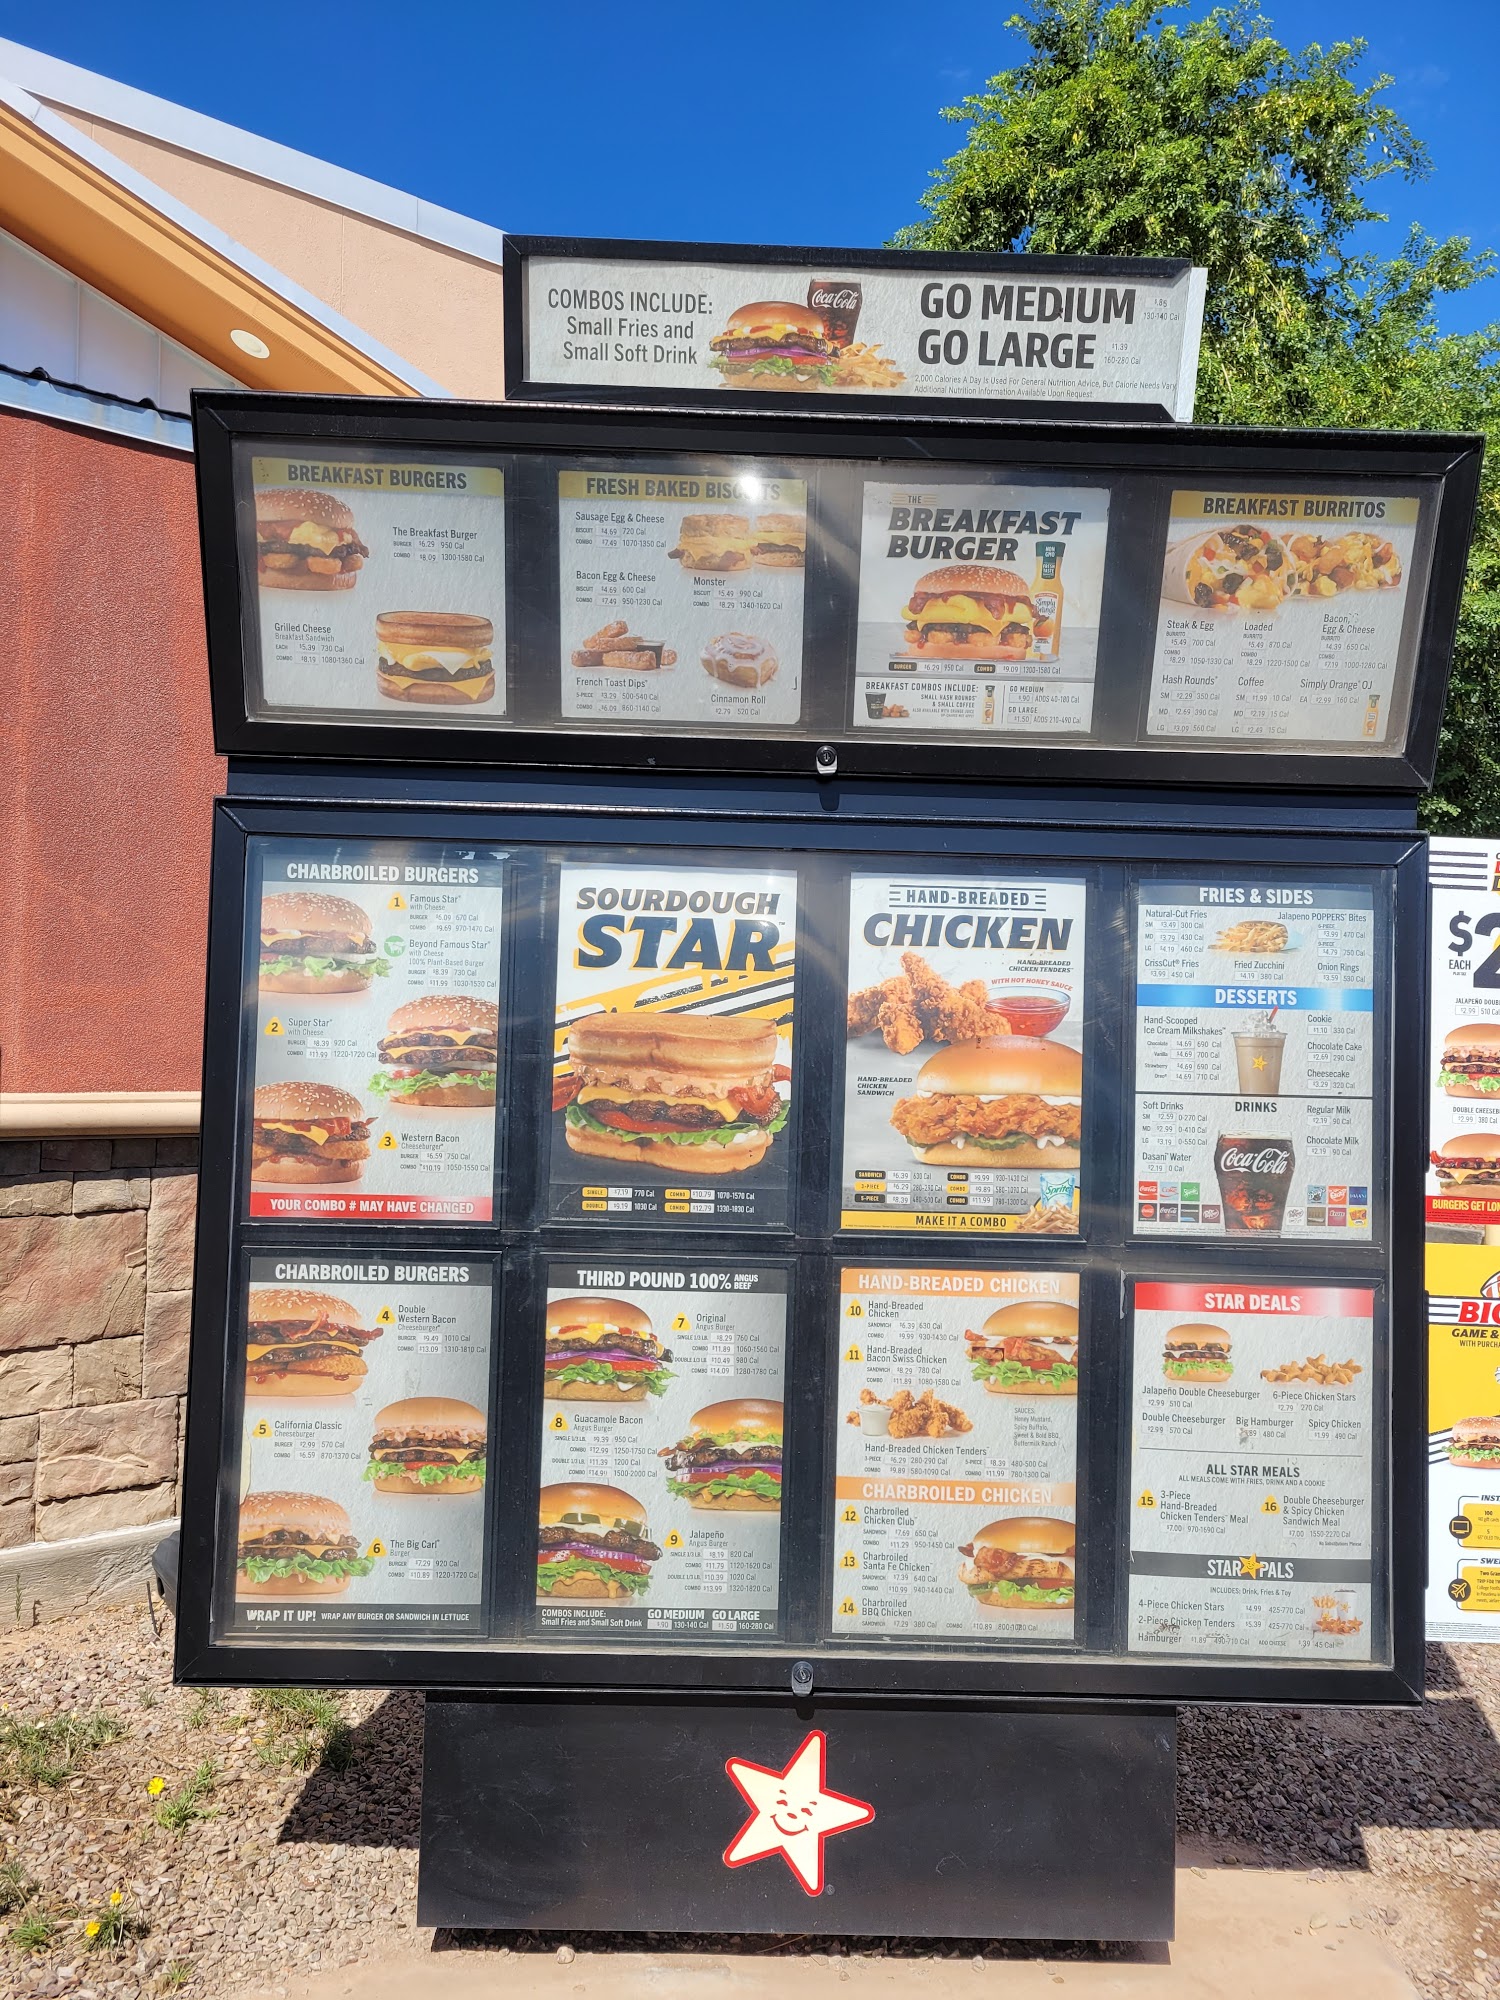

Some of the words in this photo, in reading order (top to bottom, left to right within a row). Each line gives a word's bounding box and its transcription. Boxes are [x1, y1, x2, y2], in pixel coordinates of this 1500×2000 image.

[548, 288, 625, 310] COMBOS
[629, 291, 713, 315] INCLUDE:
[920, 283, 972, 319] GO
[981, 285, 1136, 324] MEDIUM
[567, 316, 613, 336] Small
[618, 318, 658, 337] Fries
[664, 320, 694, 339] and
[563, 341, 609, 361] Small
[614, 343, 649, 363] Soft
[653, 344, 698, 365] Drink
[918, 329, 969, 365] GO
[978, 331, 1096, 369] LARGE
[288, 464, 384, 486] BREAKFAST
[390, 470, 467, 489] BURGERS
[586, 478, 639, 495] FRESH
[645, 480, 700, 497] BAKED
[706, 481, 781, 500] BISCTS
[908, 496, 922, 504] THE
[1203, 498, 1299, 516] BREAKFAST
[1303, 500, 1385, 518] BURRITOS
[575, 512, 608, 523] Sausage
[611, 513, 625, 524] Egg
[627, 514, 633, 522] &
[635, 514, 665, 524] Cheese
[888, 507, 1082, 535] BREAKFAST
[393, 527, 407, 537] The
[409, 528, 448, 538] Breakfast
[450, 530, 477, 540] Burger
[887, 535, 1019, 561] BURGER
[694, 577, 726, 586] Monster
[274, 623, 300, 633] Grilled
[302, 624, 331, 634] Cheese
[1167, 620, 1190, 630] Steak
[1192, 621, 1198, 630] &
[1200, 621, 1214, 632] Egg
[1244, 622, 1273, 632] Loaded
[866, 682, 909, 691] BREAKFAST
[911, 683, 942, 691] COMBOS
[944, 684, 978, 692] INCLUDE:
[1238, 677, 1264, 687] Coffee
[711, 694, 748, 704] Cinnamon
[751, 696, 766, 704] Roll
[287, 863, 399, 881] CHARBROILED
[404, 867, 479, 884] BURGERS
[576, 887, 781, 915] SOURDOUGH
[906, 889, 1030, 906] HAND-BREADED
[1200, 888, 1245, 904] FRIES
[1250, 888, 1262, 903] &
[1266, 889, 1313, 905] SIDES
[1145, 910, 1188, 918] Natural-Cut
[1190, 910, 1207, 919] Fries
[862, 913, 1074, 951] CHICKEN
[573, 914, 781, 972] STAR
[1234, 961, 1252, 969] Fried
[1254, 962, 1284, 970] Zucchini
[1317, 963, 1343, 971] Onion
[1346, 964, 1359, 973] Rings
[1449, 960, 1471, 970] EACH
[1215, 989, 1297, 1006] DESSERTS
[1308, 1015, 1332, 1023] Cookie
[1308, 1042, 1342, 1051] Chocolate
[1345, 1043, 1362, 1051] Cake
[1307, 1070, 1349, 1078] Cheesecake
[1143, 1101, 1158, 1110] Soft
[1160, 1102, 1183, 1110] Drinks
[1235, 1102, 1277, 1113] DRINKS
[384, 1137, 391, 1146] 3
[401, 1133, 433, 1143] Western
[436, 1134, 460, 1143] Bacon
[1220, 1147, 1290, 1174] Coca-Cola
[1046, 1185, 1071, 1196] Sprite
[270, 1199, 302, 1211] YOUR
[305, 1200, 346, 1212] COMBO
[349, 1201, 356, 1211] #
[359, 1201, 384, 1212] MAY
[387, 1201, 417, 1213] HAVE
[419, 1202, 474, 1214] CHANGED
[1432, 1199, 1469, 1210] BURGERS
[1471, 1201, 1486, 1211] GET
[916, 1216, 944, 1226] MAKE
[948, 1216, 957, 1226] IT
[960, 1217, 967, 1226] A
[970, 1217, 1006, 1227] COMBO
[275, 1264, 389, 1282] CHARBROILED
[394, 1266, 470, 1282] BURGERS
[734, 1274, 758, 1282] ANGUS
[577, 1270, 625, 1286] THIRD
[629, 1272, 685, 1288] POUND
[690, 1273, 731, 1290] 100%
[734, 1282, 751, 1290] BEEF
[859, 1275, 984, 1292] HAND-BREADED
[990, 1277, 1060, 1294] CHICKEN
[1204, 1293, 1245, 1310] STAR
[850, 1306, 861, 1316] 10
[868, 1301, 924, 1311] Hand-Breaded
[398, 1315, 430, 1324] Western
[432, 1315, 456, 1324] Bacon
[677, 1318, 684, 1327] 7
[696, 1313, 726, 1323] Original
[1452, 1329, 1488, 1338] GAME
[1490, 1330, 1499, 1338] &
[1142, 1386, 1177, 1396] Jalapeño
[1179, 1387, 1205, 1396] Double
[1208, 1389, 1260, 1400] Cheeseburger
[259, 1425, 266, 1434] 5
[274, 1421, 312, 1430] California
[315, 1422, 342, 1430] Classic
[555, 1418, 562, 1428] 8
[574, 1414, 617, 1424] Guacamole
[619, 1416, 643, 1424] Bacon
[1206, 1464, 1228, 1475] ALL
[1231, 1465, 1260, 1476] STAR
[1262, 1466, 1300, 1478] MEALS
[863, 1483, 975, 1502] CHARBROILED
[982, 1487, 1052, 1504] CHICKEN
[845, 1511, 856, 1521] 12
[864, 1507, 909, 1516] Charbroiled
[670, 1535, 678, 1545] 9
[689, 1530, 724, 1539] Jalapeño
[1207, 1560, 1241, 1576] STAR
[1138, 1600, 1169, 1609] 4-Piece
[1170, 1602, 1203, 1611] Chicken
[1205, 1602, 1224, 1611] Stars
[246, 1610, 280, 1621] WRAP
[283, 1611, 295, 1621] IT
[298, 1611, 316, 1622] UP!
[321, 1612, 340, 1620] WRAP
[357, 1613, 383, 1621] BURGER
[385, 1613, 395, 1621] OR
[396, 1613, 431, 1621] SANDWICH
[432, 1613, 439, 1621] IN
[440, 1613, 469, 1621] LETTUCE
[647, 1609, 662, 1619] GO
[664, 1609, 705, 1619] MEDIUM
[712, 1610, 726, 1620] GO
[728, 1611, 759, 1620] LARGE
[862, 1608, 879, 1617] BBQ
[881, 1608, 912, 1617] Chicken
